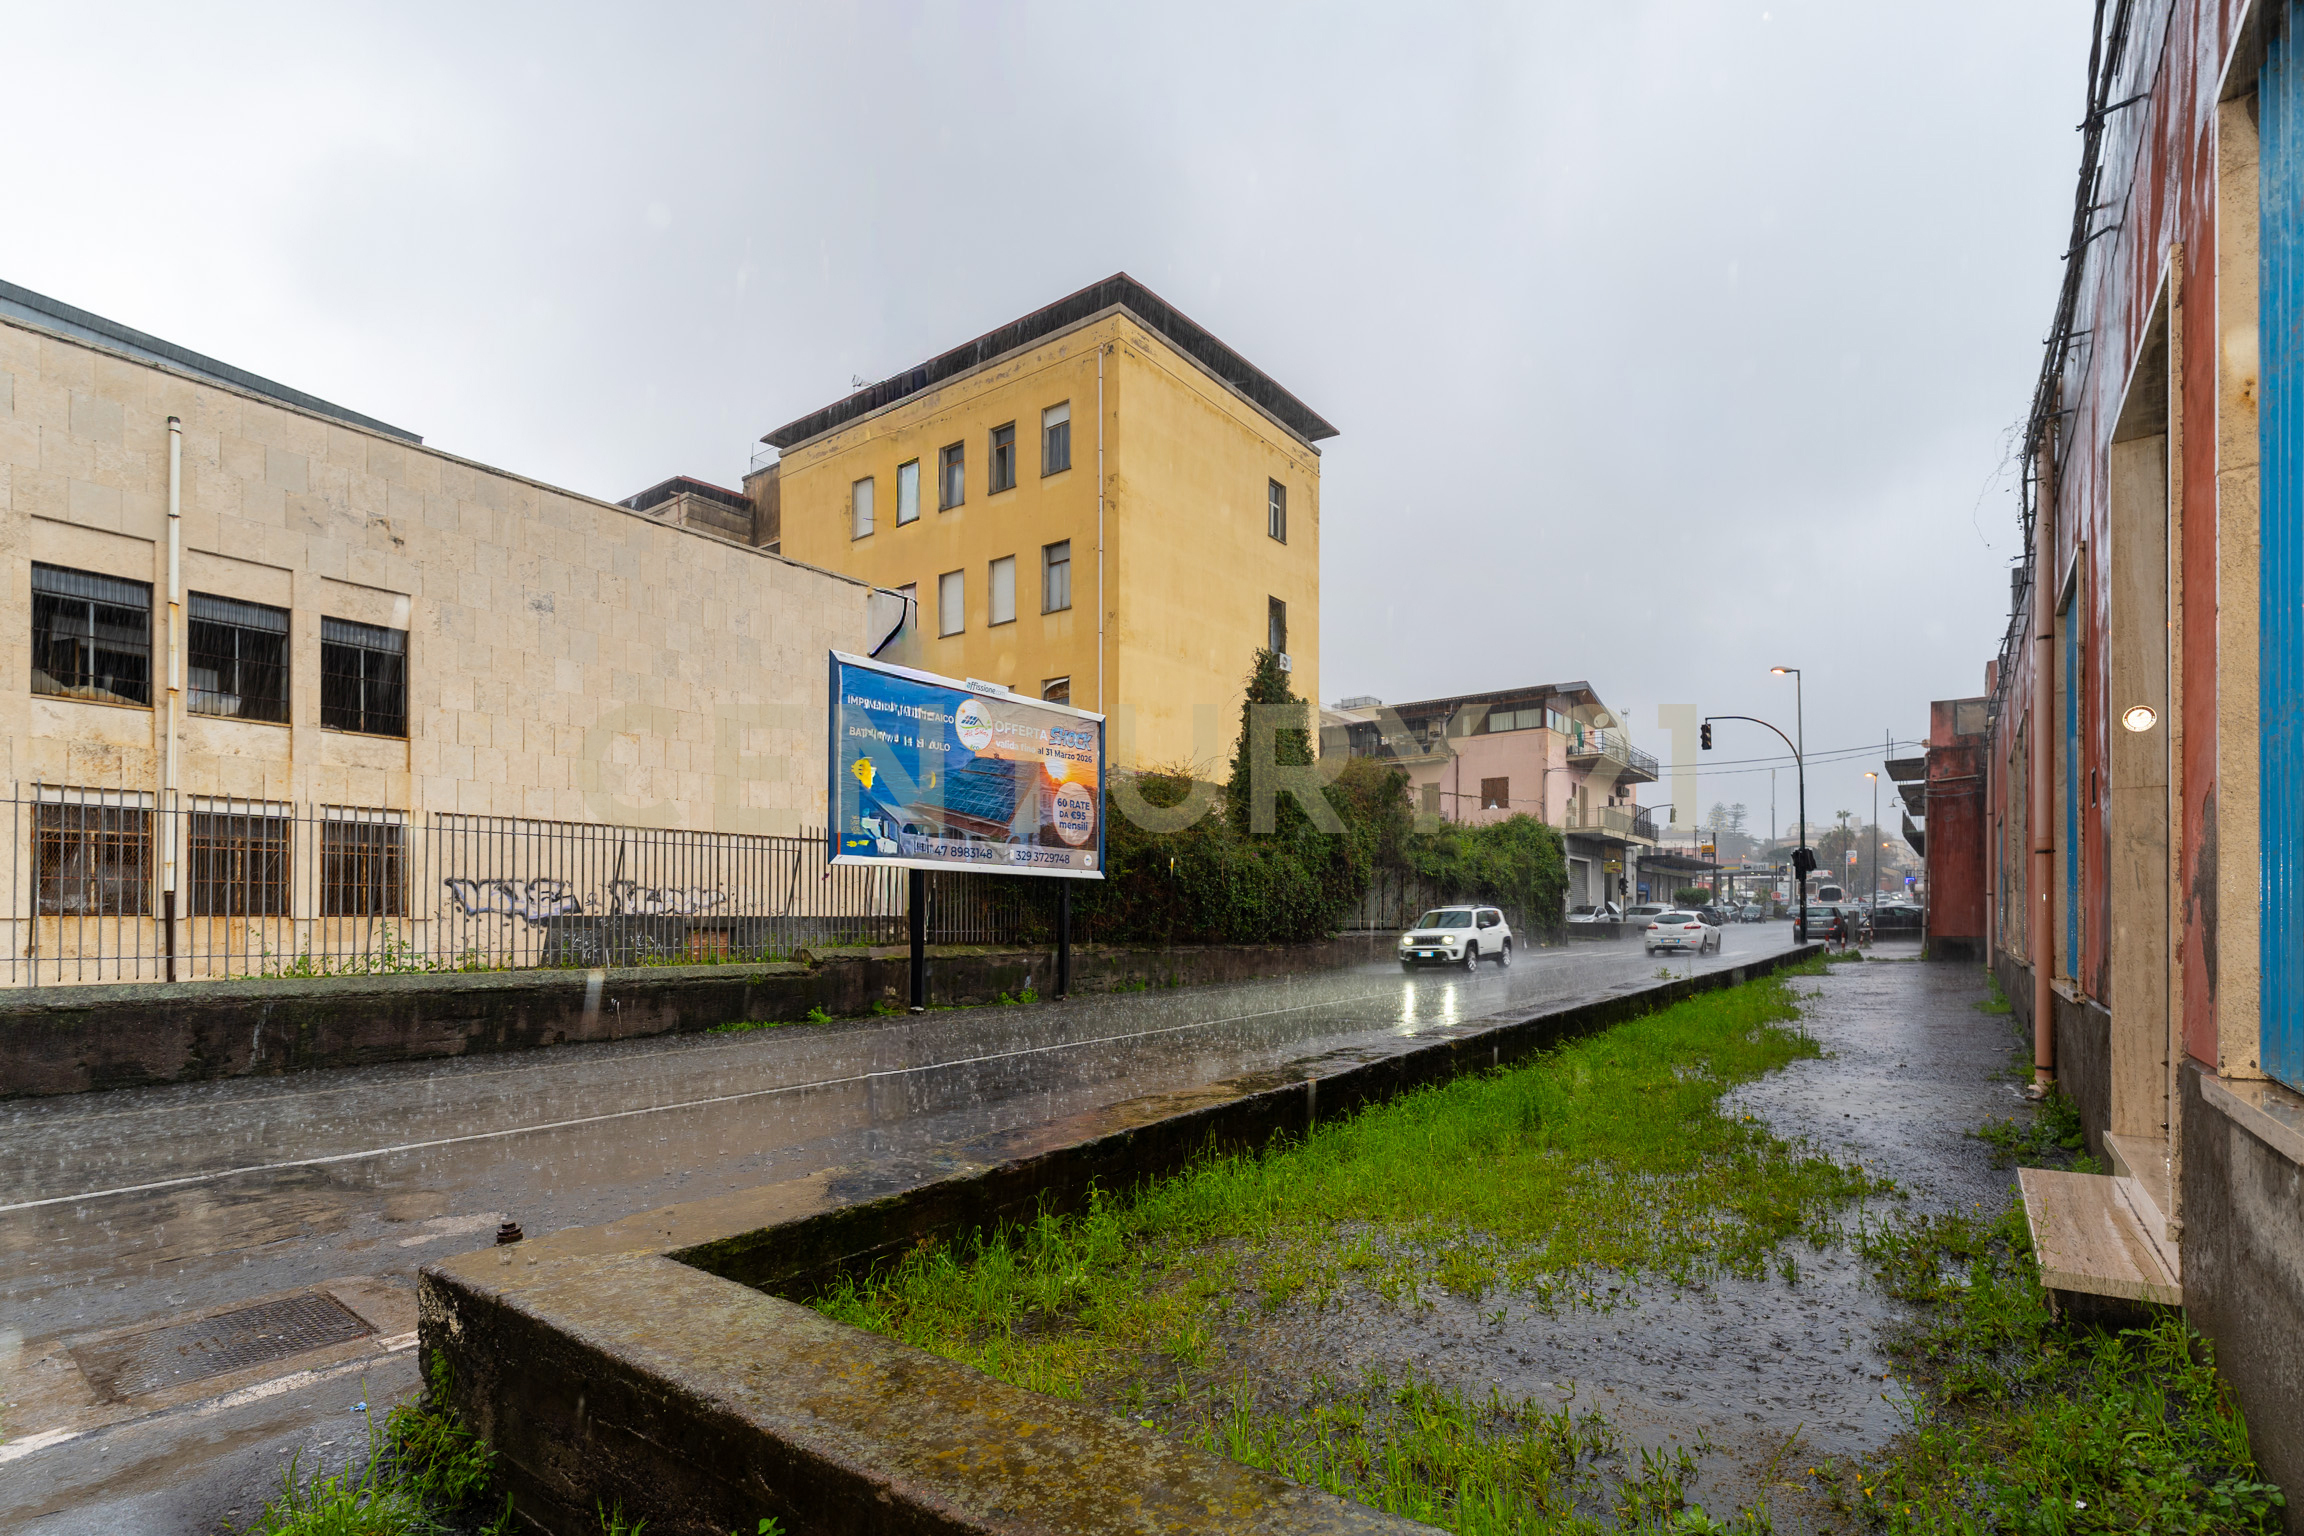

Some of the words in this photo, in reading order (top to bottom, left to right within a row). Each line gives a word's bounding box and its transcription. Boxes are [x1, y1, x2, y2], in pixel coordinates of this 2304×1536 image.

[966, 681, 1005, 696] affissione.com
[995, 720, 1048, 741] OFFERTA
[1049, 725, 1093, 751] SHOCK
[995, 740, 1019, 751] valida
[1020, 743, 1036, 754] fino
[1037, 747, 1044, 755] al
[1046, 748, 1053, 757] 31
[1054, 749, 1075, 760] Marzo
[1076, 753, 1093, 763] 2026
[1057, 798, 1068, 808] 60
[1069, 799, 1091, 811] RATE
[1059, 810, 1069, 819] DA
[1070, 811, 1087, 820] €95
[1058, 821, 1089, 832] mensili
[950, 846, 993, 859] 8983148
[1015, 850, 1032, 861] 329
[1033, 851, 1070, 864] 3729748
